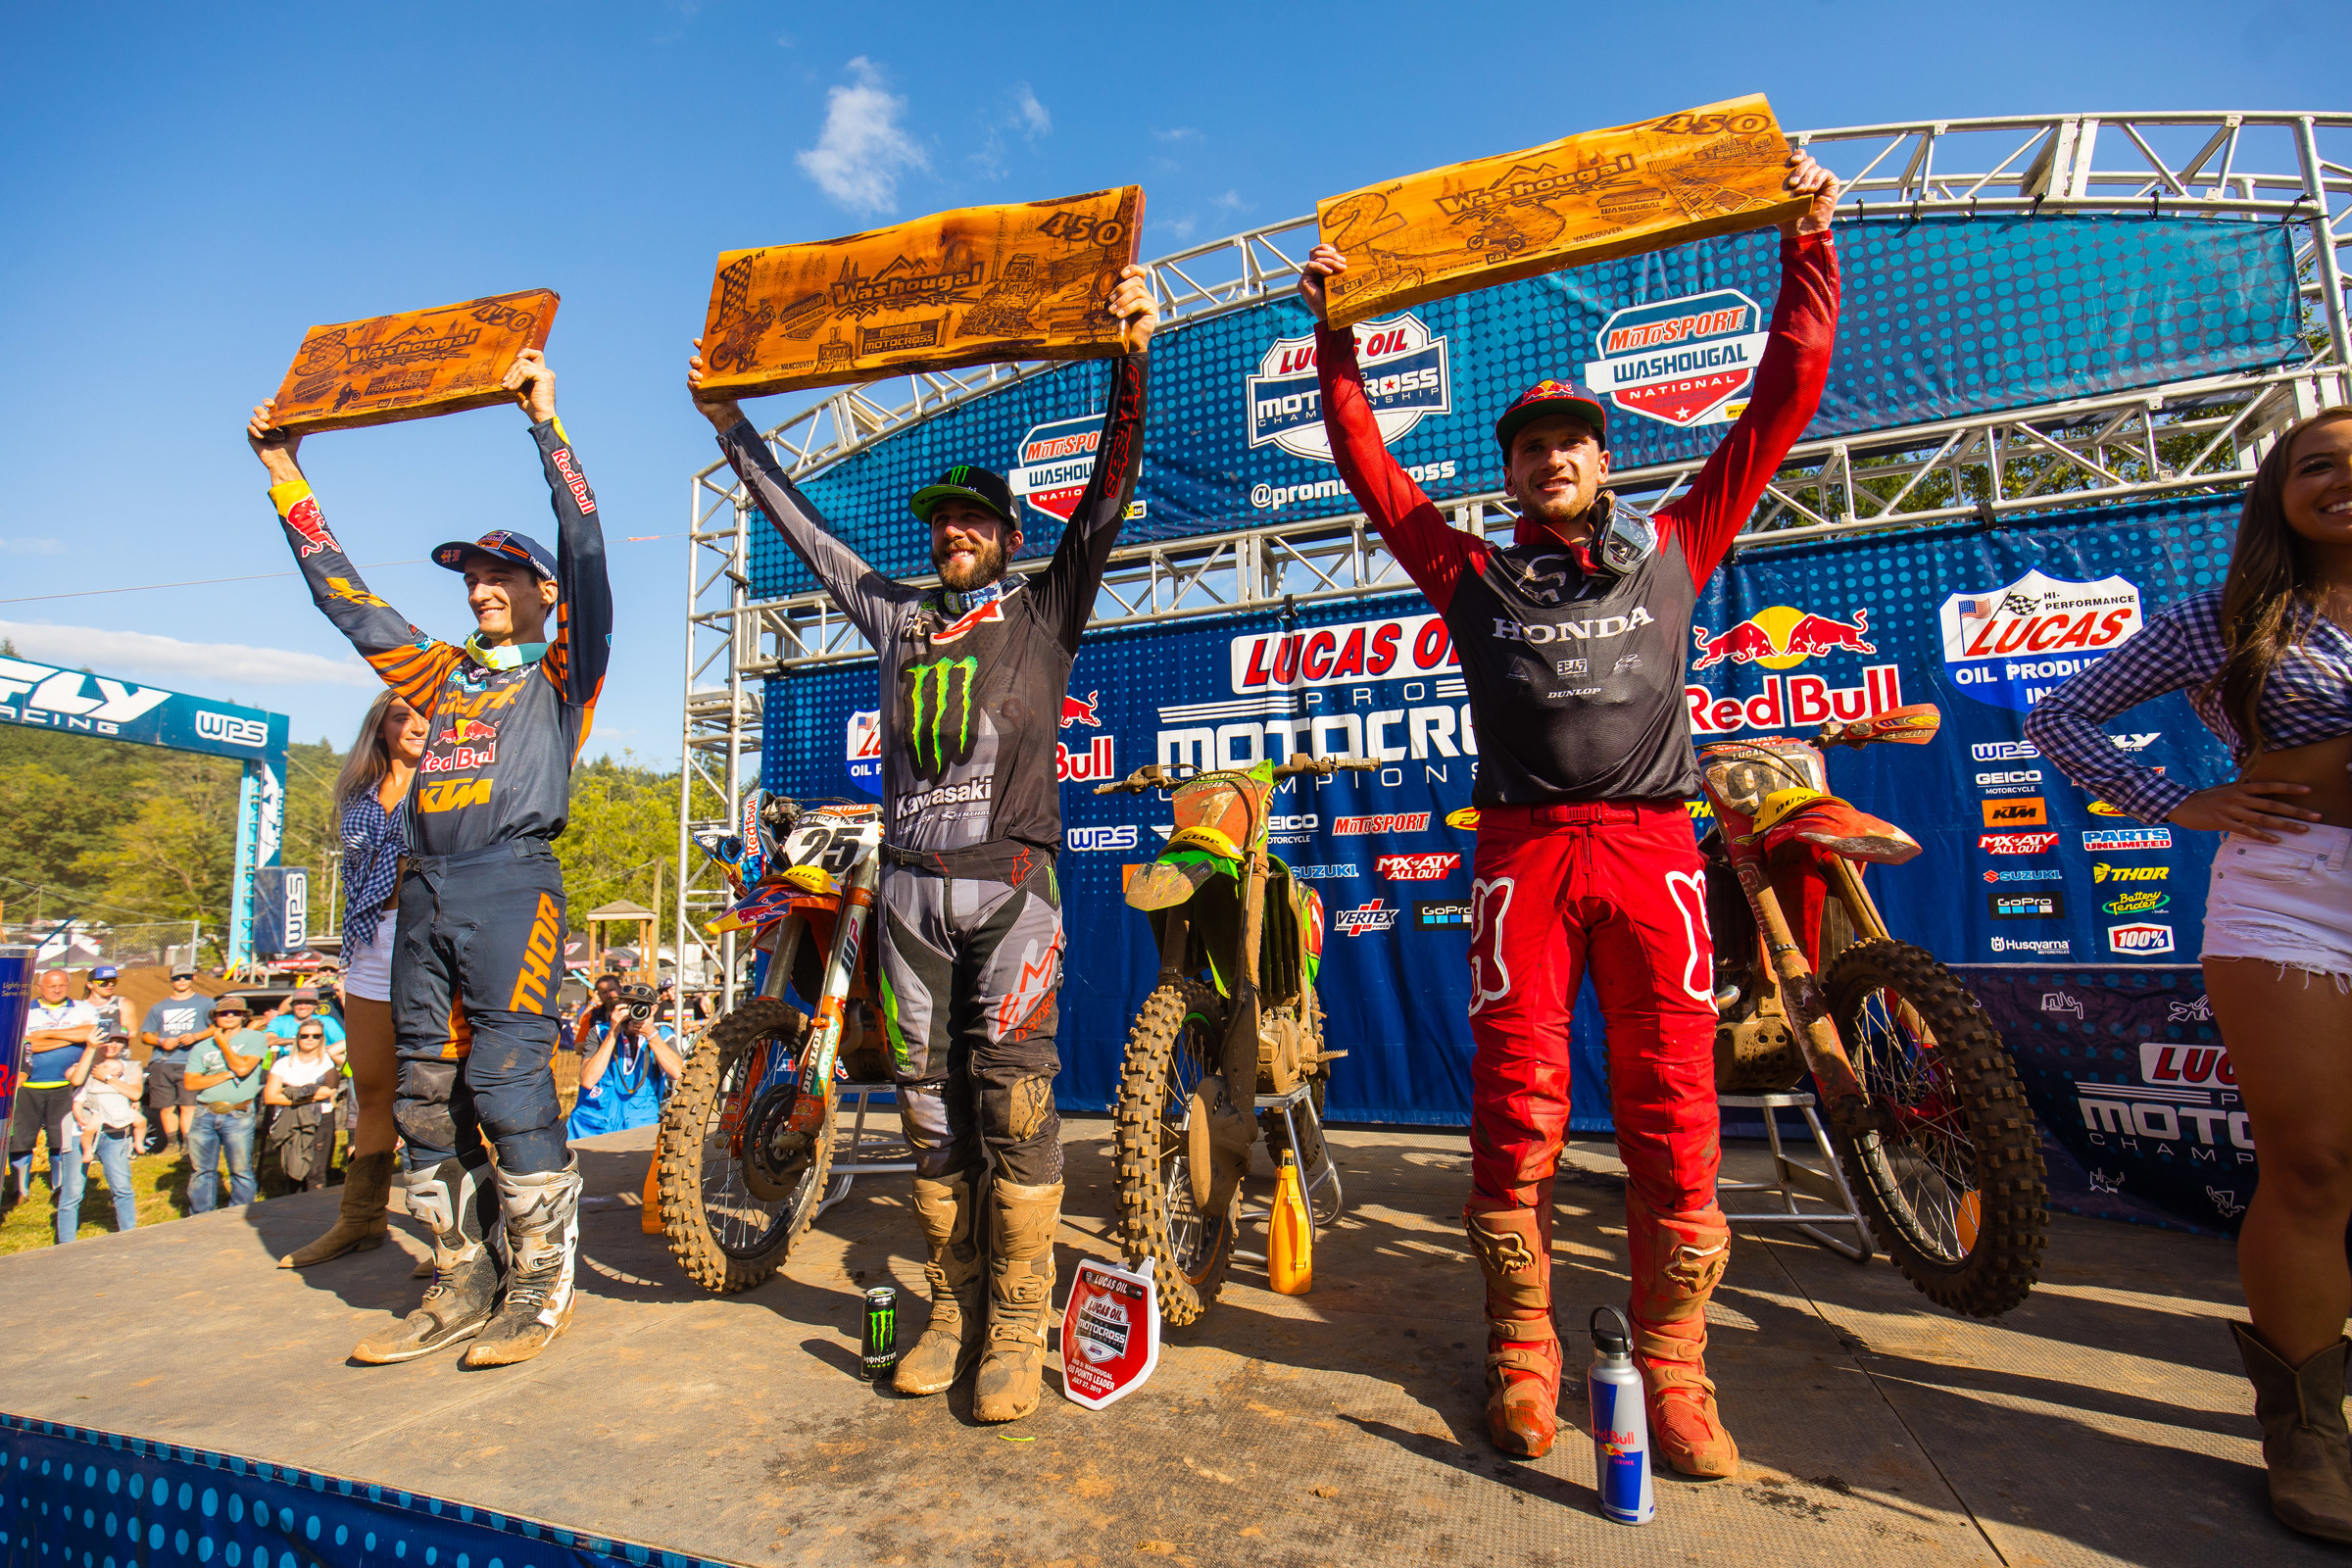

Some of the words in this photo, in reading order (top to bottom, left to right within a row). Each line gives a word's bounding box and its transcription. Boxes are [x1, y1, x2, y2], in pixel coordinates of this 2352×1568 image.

[1651, 114, 1771, 135] 450
[1435, 154, 1638, 217] Washougal
[1036, 211, 1125, 247] 450
[1488, 253, 1506, 264] CAT
[830, 261, 985, 309] Washougal
[1091, 301, 1106, 311] CAT
[470, 303, 536, 332] 450
[348, 326, 482, 364] Washougal
[864, 334, 935, 351] MOTOCROSS
[1367, 328, 1408, 358] OIL
[1613, 343, 1748, 383] WASHOUGAL
[1257, 367, 1438, 419] MOTROSS
[1629, 375, 1736, 400] NATIONAL
[1029, 462, 1093, 488] WASHOU
[1039, 488, 1083, 502] NATIO
[2043, 591, 2060, 600] HI-
[2045, 595, 2135, 610] PERFORMANCE
[1493, 606, 1655, 645] HONDA
[1964, 608, 2132, 658] LUCAS
[1243, 622, 1402, 688] LUCAS
[1412, 617, 1461, 670] OI
[1955, 666, 1998, 685] OIL
[2005, 657, 2101, 680] PRODU
[1305, 682, 1426, 710] PRO
[1546, 687, 1602, 699] DUNLOP
[1685, 674, 1787, 734] Red
[1787, 664, 1903, 727] Bull
[0, 706, 121, 735] ACING
[196, 710, 269, 748] WPS
[1157, 705, 1478, 778] MOTOCR
[2109, 732, 2162, 749] LY
[1055, 735, 1114, 782] Bull
[1733, 748, 1764, 760] LUCAS
[1972, 741, 2041, 761] WPS
[851, 763, 872, 777] OIL
[1976, 770, 2042, 784] GEICO
[417, 778, 494, 814] KTM
[895, 778, 992, 819] Kawasaki
[1985, 786, 2035, 795] MOTORCYCLE
[1684, 801, 1714, 818] TH
[1775, 795, 1809, 815] DUN
[1991, 805, 2037, 820] KTM
[1268, 813, 1319, 830] EICO
[1067, 825, 1138, 852] WPS
[1267, 835, 1310, 845] OTORCYCLE
[1979, 836, 2013, 849] MX
[2018, 834, 2058, 846] ATV
[2083, 828, 2171, 843] PARTS
[794, 827, 864, 875] 25
[1989, 845, 2015, 855] ALL
[2015, 845, 2043, 854] OUT
[2084, 840, 2172, 851] UNLIMITED
[1291, 863, 1357, 880] SUZUKI
[1376, 857, 1412, 871] MX
[1418, 854, 1460, 869] ATV
[1387, 869, 1414, 881] ALL
[1416, 867, 1444, 879] OUT
[1998, 869, 2060, 882] SUZUKI
[2112, 866, 2170, 882] THOR
[1997, 897, 2052, 906] GoPro
[2119, 891, 2162, 904] Battery
[284, 872, 307, 950] WPS
[1336, 909, 1400, 925] VERTEX
[2109, 899, 2157, 916] Tender
[2005, 939, 2069, 953] Husqvarna
[2118, 930, 2165, 949] 100%
[509, 892, 560, 1015] THOR
[802, 1028, 823, 1095] DUNLOP
[2152, 1046, 2235, 1086] LUC
[1094, 1274, 1117, 1291] LUCAS
[1115, 1281, 1128, 1294] OIL
[1088, 1299, 1110, 1317] LUCAS
[1109, 1307, 1122, 1322] OIL
[1079, 1318, 1126, 1345] MOTOCROSS
[863, 1350, 897, 1365] MONSTER
[1075, 1366, 1094, 1382] POINTS
[1092, 1375, 1115, 1392] LEADER
[1084, 1363, 1113, 1381] WASHOUGAL
[1071, 1376, 1083, 1386] JULY
[1089, 1384, 1102, 1395] 2019
[1609, 1430, 1635, 1446] Bull
[1613, 1458, 1635, 1467] DRINK
